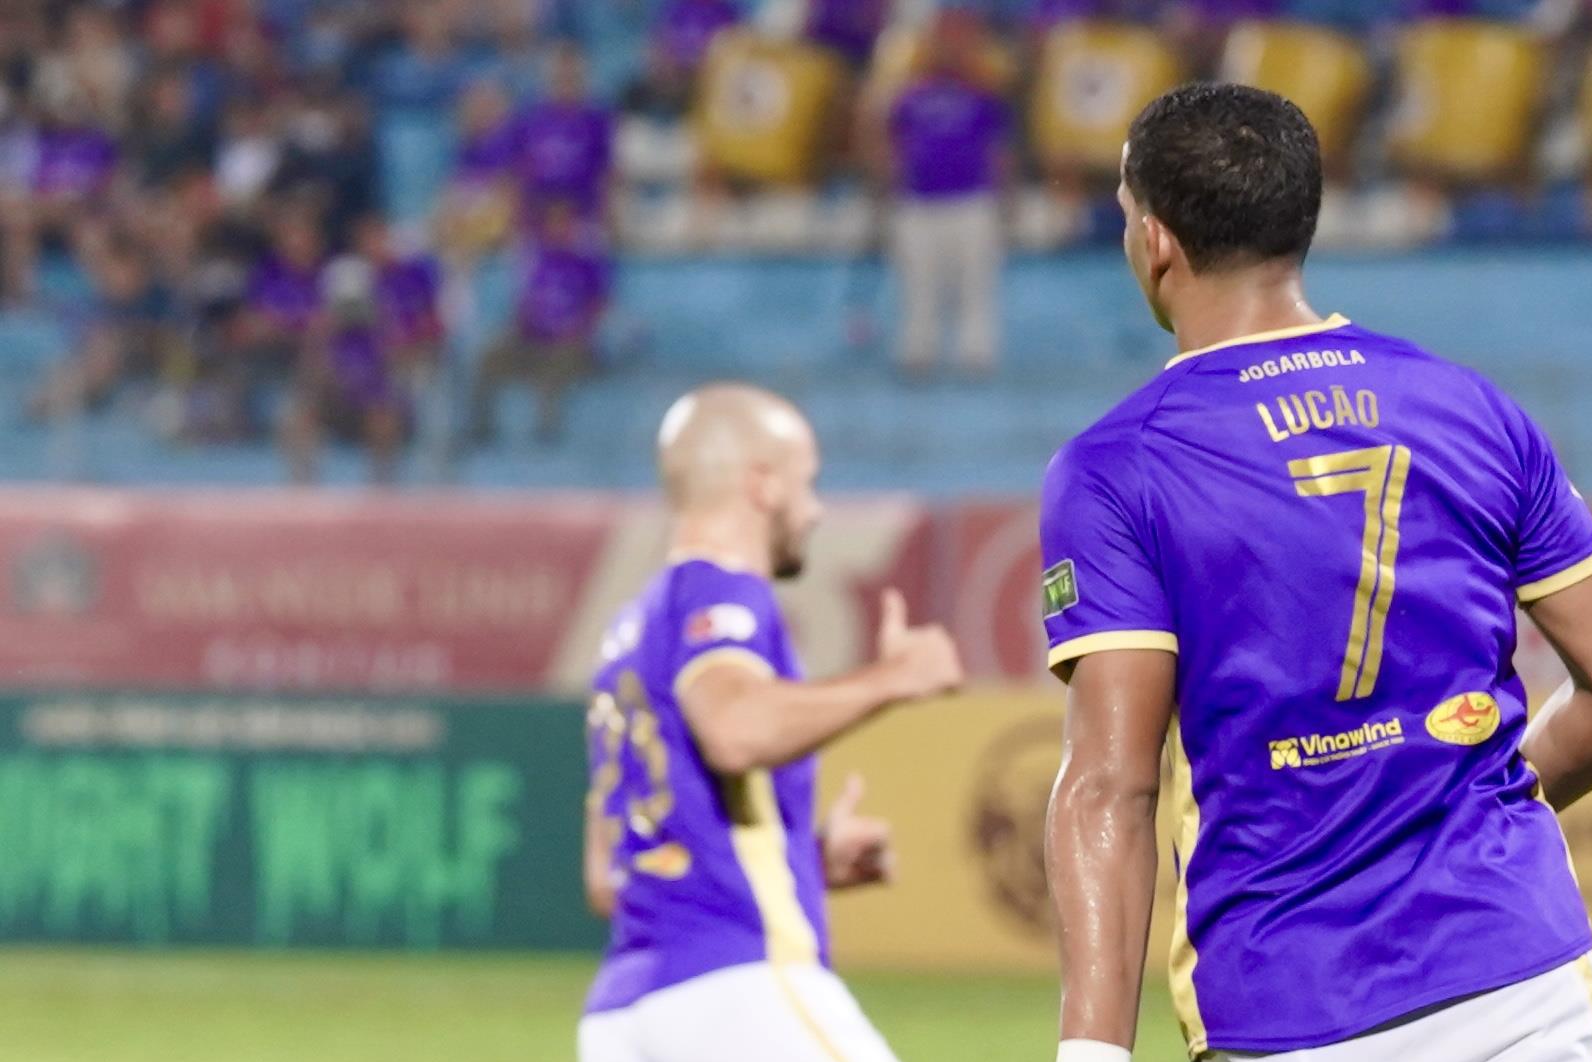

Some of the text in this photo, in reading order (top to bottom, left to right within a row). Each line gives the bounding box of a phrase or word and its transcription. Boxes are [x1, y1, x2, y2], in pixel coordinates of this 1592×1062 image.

[1239, 350, 1366, 382] JOGARBOLA
[1256, 385, 1380, 442] LUCÃO
[1287, 445, 1411, 701] 7
[1301, 717, 1402, 756] Vinawind
